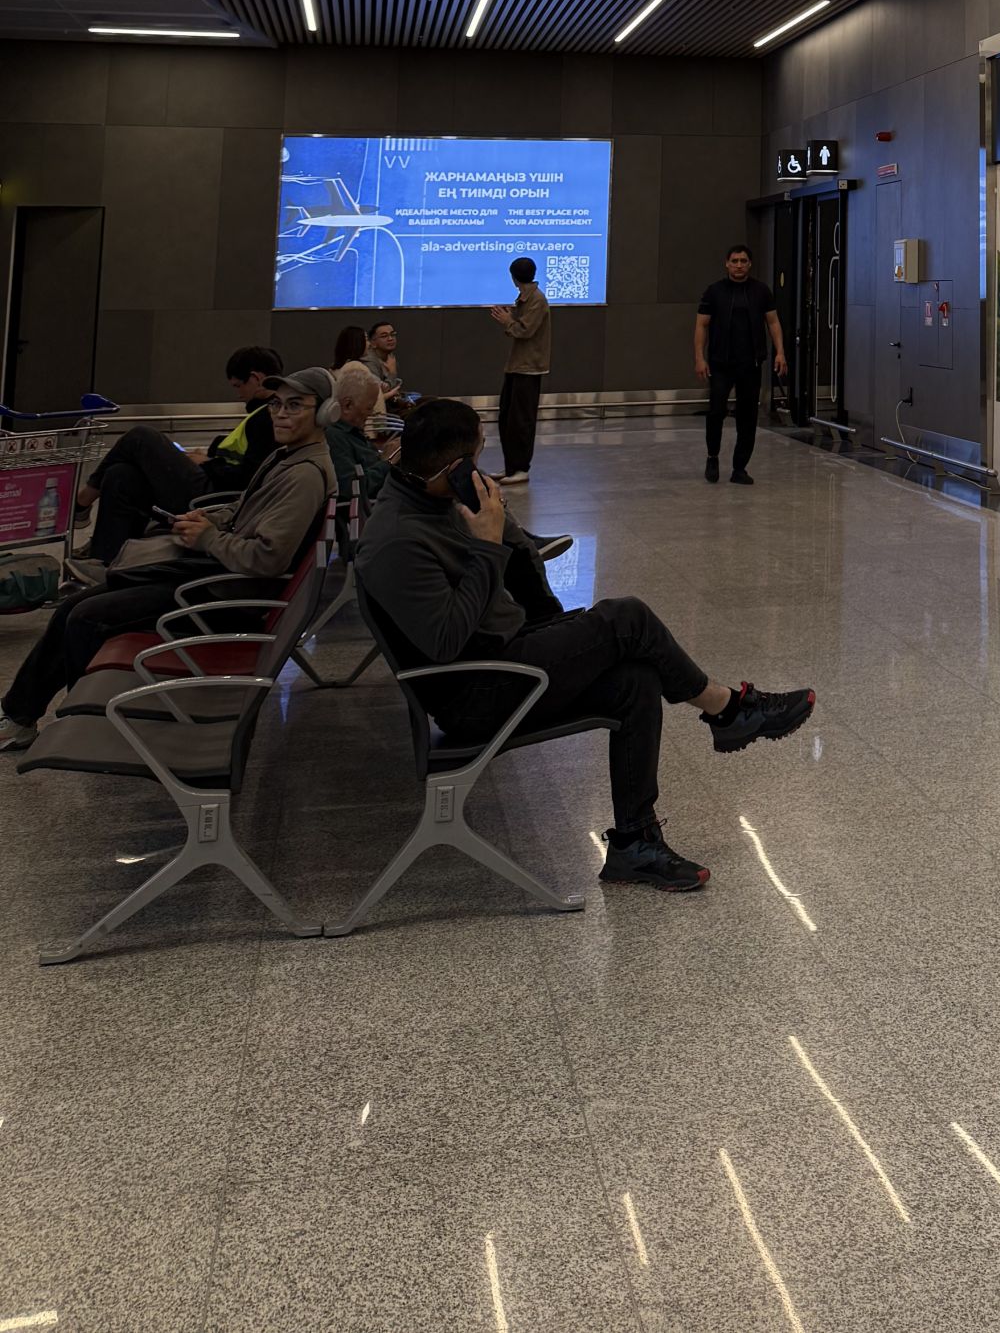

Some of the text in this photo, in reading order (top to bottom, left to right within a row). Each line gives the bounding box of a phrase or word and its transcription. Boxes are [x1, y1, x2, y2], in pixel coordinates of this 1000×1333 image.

[425, 171, 564, 183] ЖАРНАМАҢЫЗ ҮШІН
[438, 188, 550, 199] ЕҢ ТИІМДІ ОРЫН
[395, 209, 449, 217] ИДЕАЛЬНОЕ
[480, 209, 499, 217] ДЛЯ
[408, 217, 484, 226] ВАШЕЙ РЕКЛАМЫ
[503, 218, 593, 226] YOUR ADVERTISEMENT
[420, 241, 575, 254] ala-advertising@tav.aero
